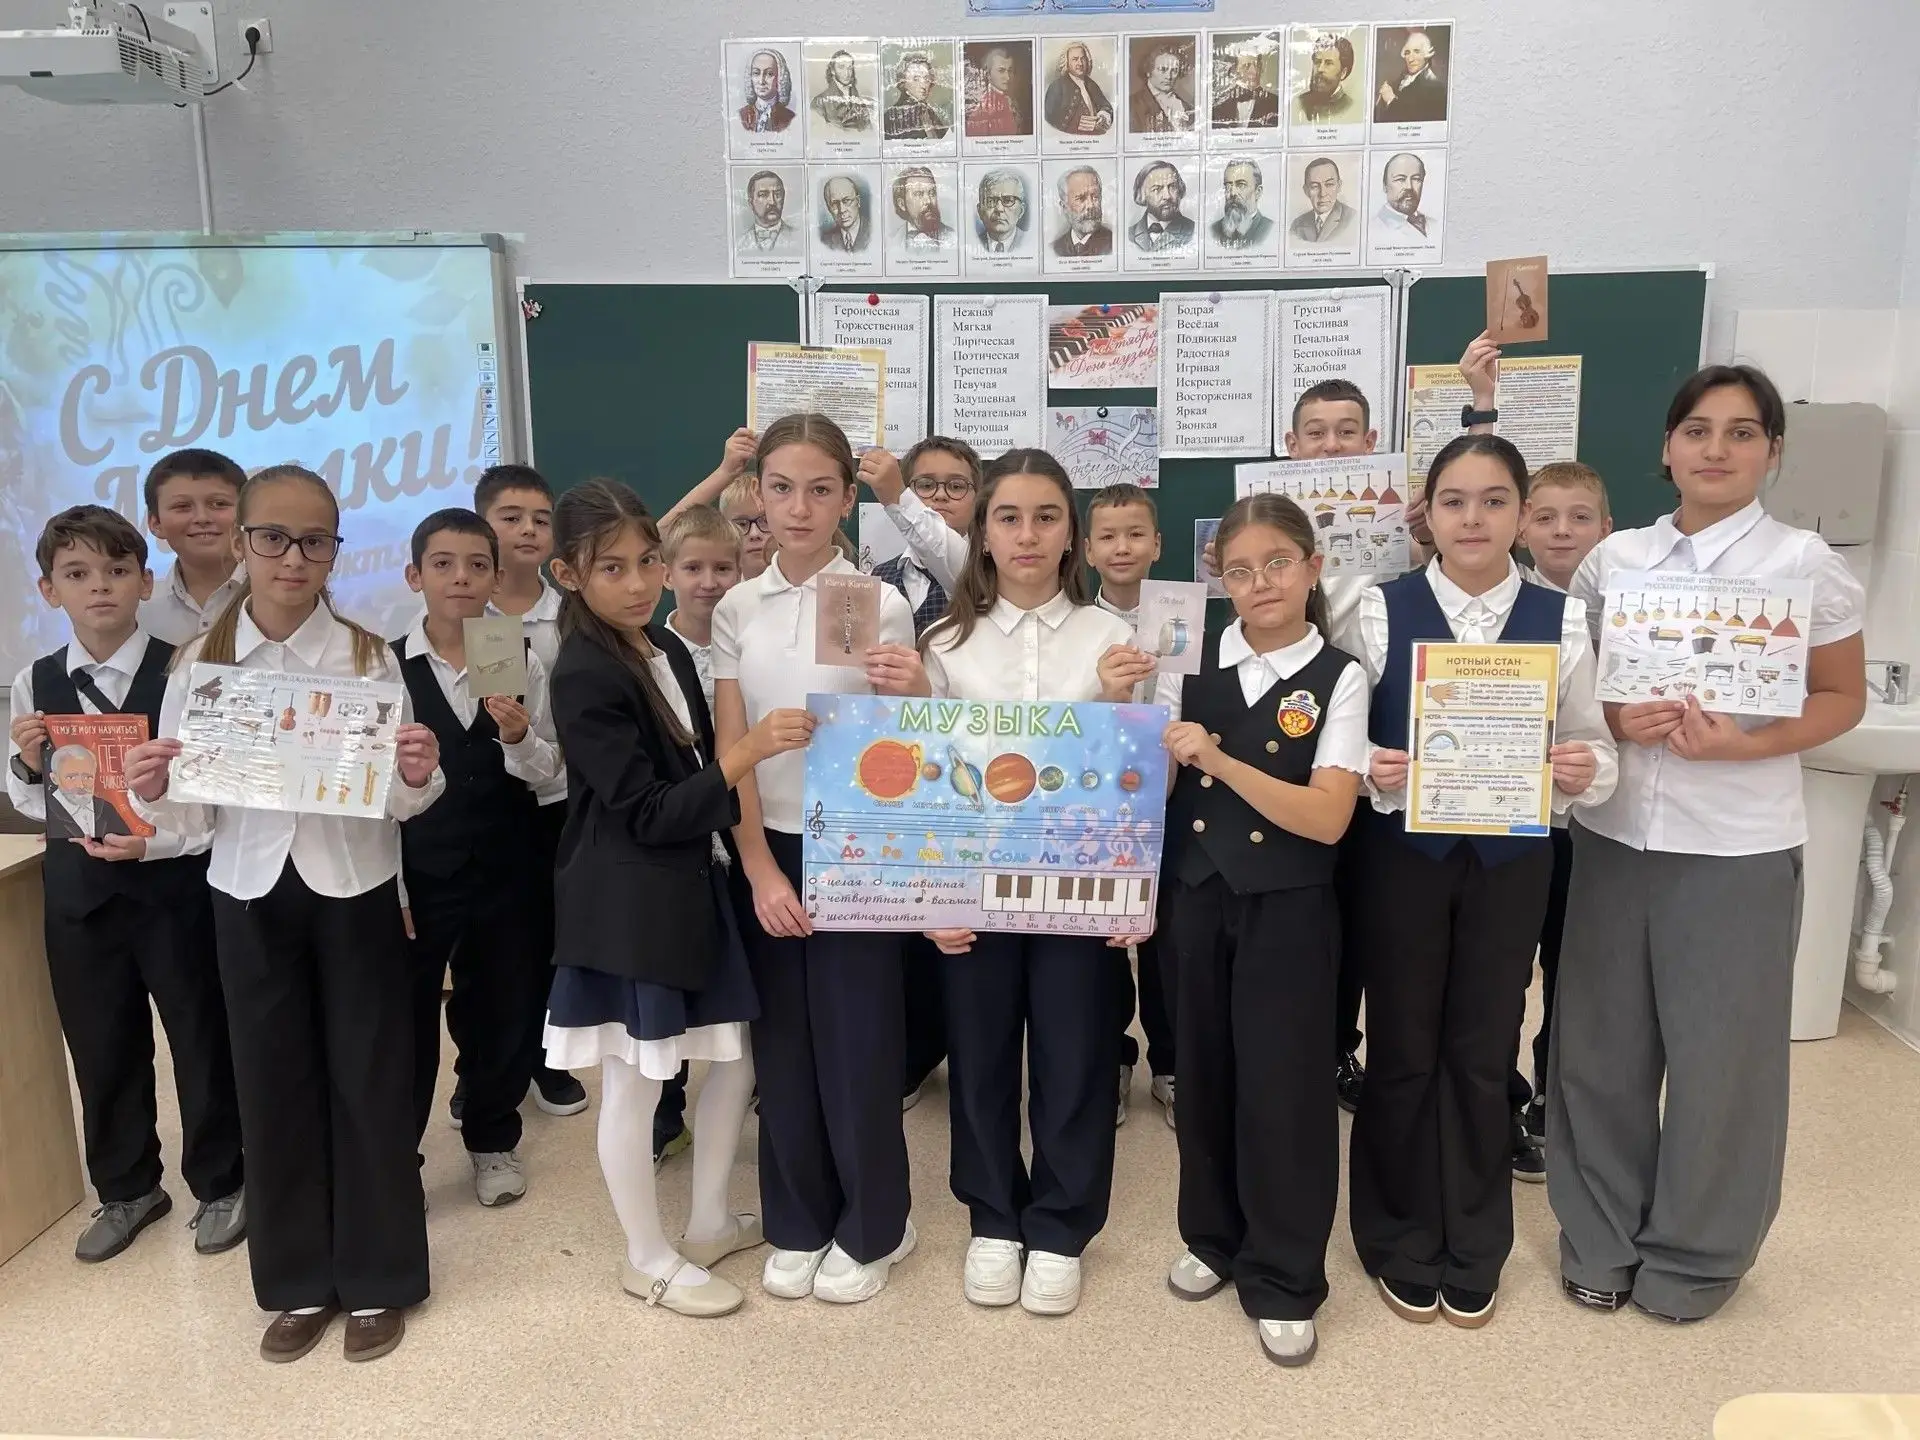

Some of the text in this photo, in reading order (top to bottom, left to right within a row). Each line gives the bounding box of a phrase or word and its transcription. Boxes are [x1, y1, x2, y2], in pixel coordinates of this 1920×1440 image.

[834, 306, 900, 316] Героическая
[953, 307, 993, 317] Нежная
[1177, 304, 1214, 316] Бодрая
[1293, 304, 1342, 315] Грустная
[834, 320, 914, 331] Торжественная
[953, 322, 992, 332] Мягкая
[1177, 318, 1219, 329] Весёлая
[1294, 318, 1349, 330] Тоскливая
[834, 334, 892, 345] Призывная
[953, 336, 1015, 347] Лирическая
[1177, 333, 1237, 344] Подвижная
[1293, 332, 1350, 344] Печальная
[774, 352, 828, 360] МУЗЫКАЛЬНЫЕ
[953, 351, 1019, 360] Поэтическая
[1176, 348, 1230, 359] Радостная
[1293, 346, 1361, 359] Беспокойная
[953, 365, 1007, 376] Трепетная
[1176, 362, 1220, 374] Игривая
[1293, 362, 1347, 372] Жалобная
[953, 380, 997, 390] Певучая
[1176, 377, 1232, 388] Искристая
[953, 394, 1016, 404] Задушевная
[1176, 390, 1252, 402] Восторженная
[60, 337, 411, 467] С Днем
[954, 408, 1027, 418] Мечтательная
[1176, 406, 1207, 417] Яркая
[954, 422, 1009, 434] Чарующая
[1176, 420, 1218, 430] Звонкая
[1176, 434, 1245, 445] Праздничная
[1446, 656, 1522, 666] НОТНЫЙ СТАН
[1456, 668, 1520, 678] НОТОНОСЕЦ
[900, 702, 1082, 738] МУЗЫКА
[52, 726, 70, 735] ЧЕМУ
[79, 726, 96, 734] МОГУ
[98, 725, 138, 735] НАУЧИТЬСЯ
[840, 846, 1138, 866] До Ре Ми Фа Соль Ля Си До
[987, 912, 996, 920] C
[1028, 914, 1035, 922] E
[1089, 916, 1096, 924] A
